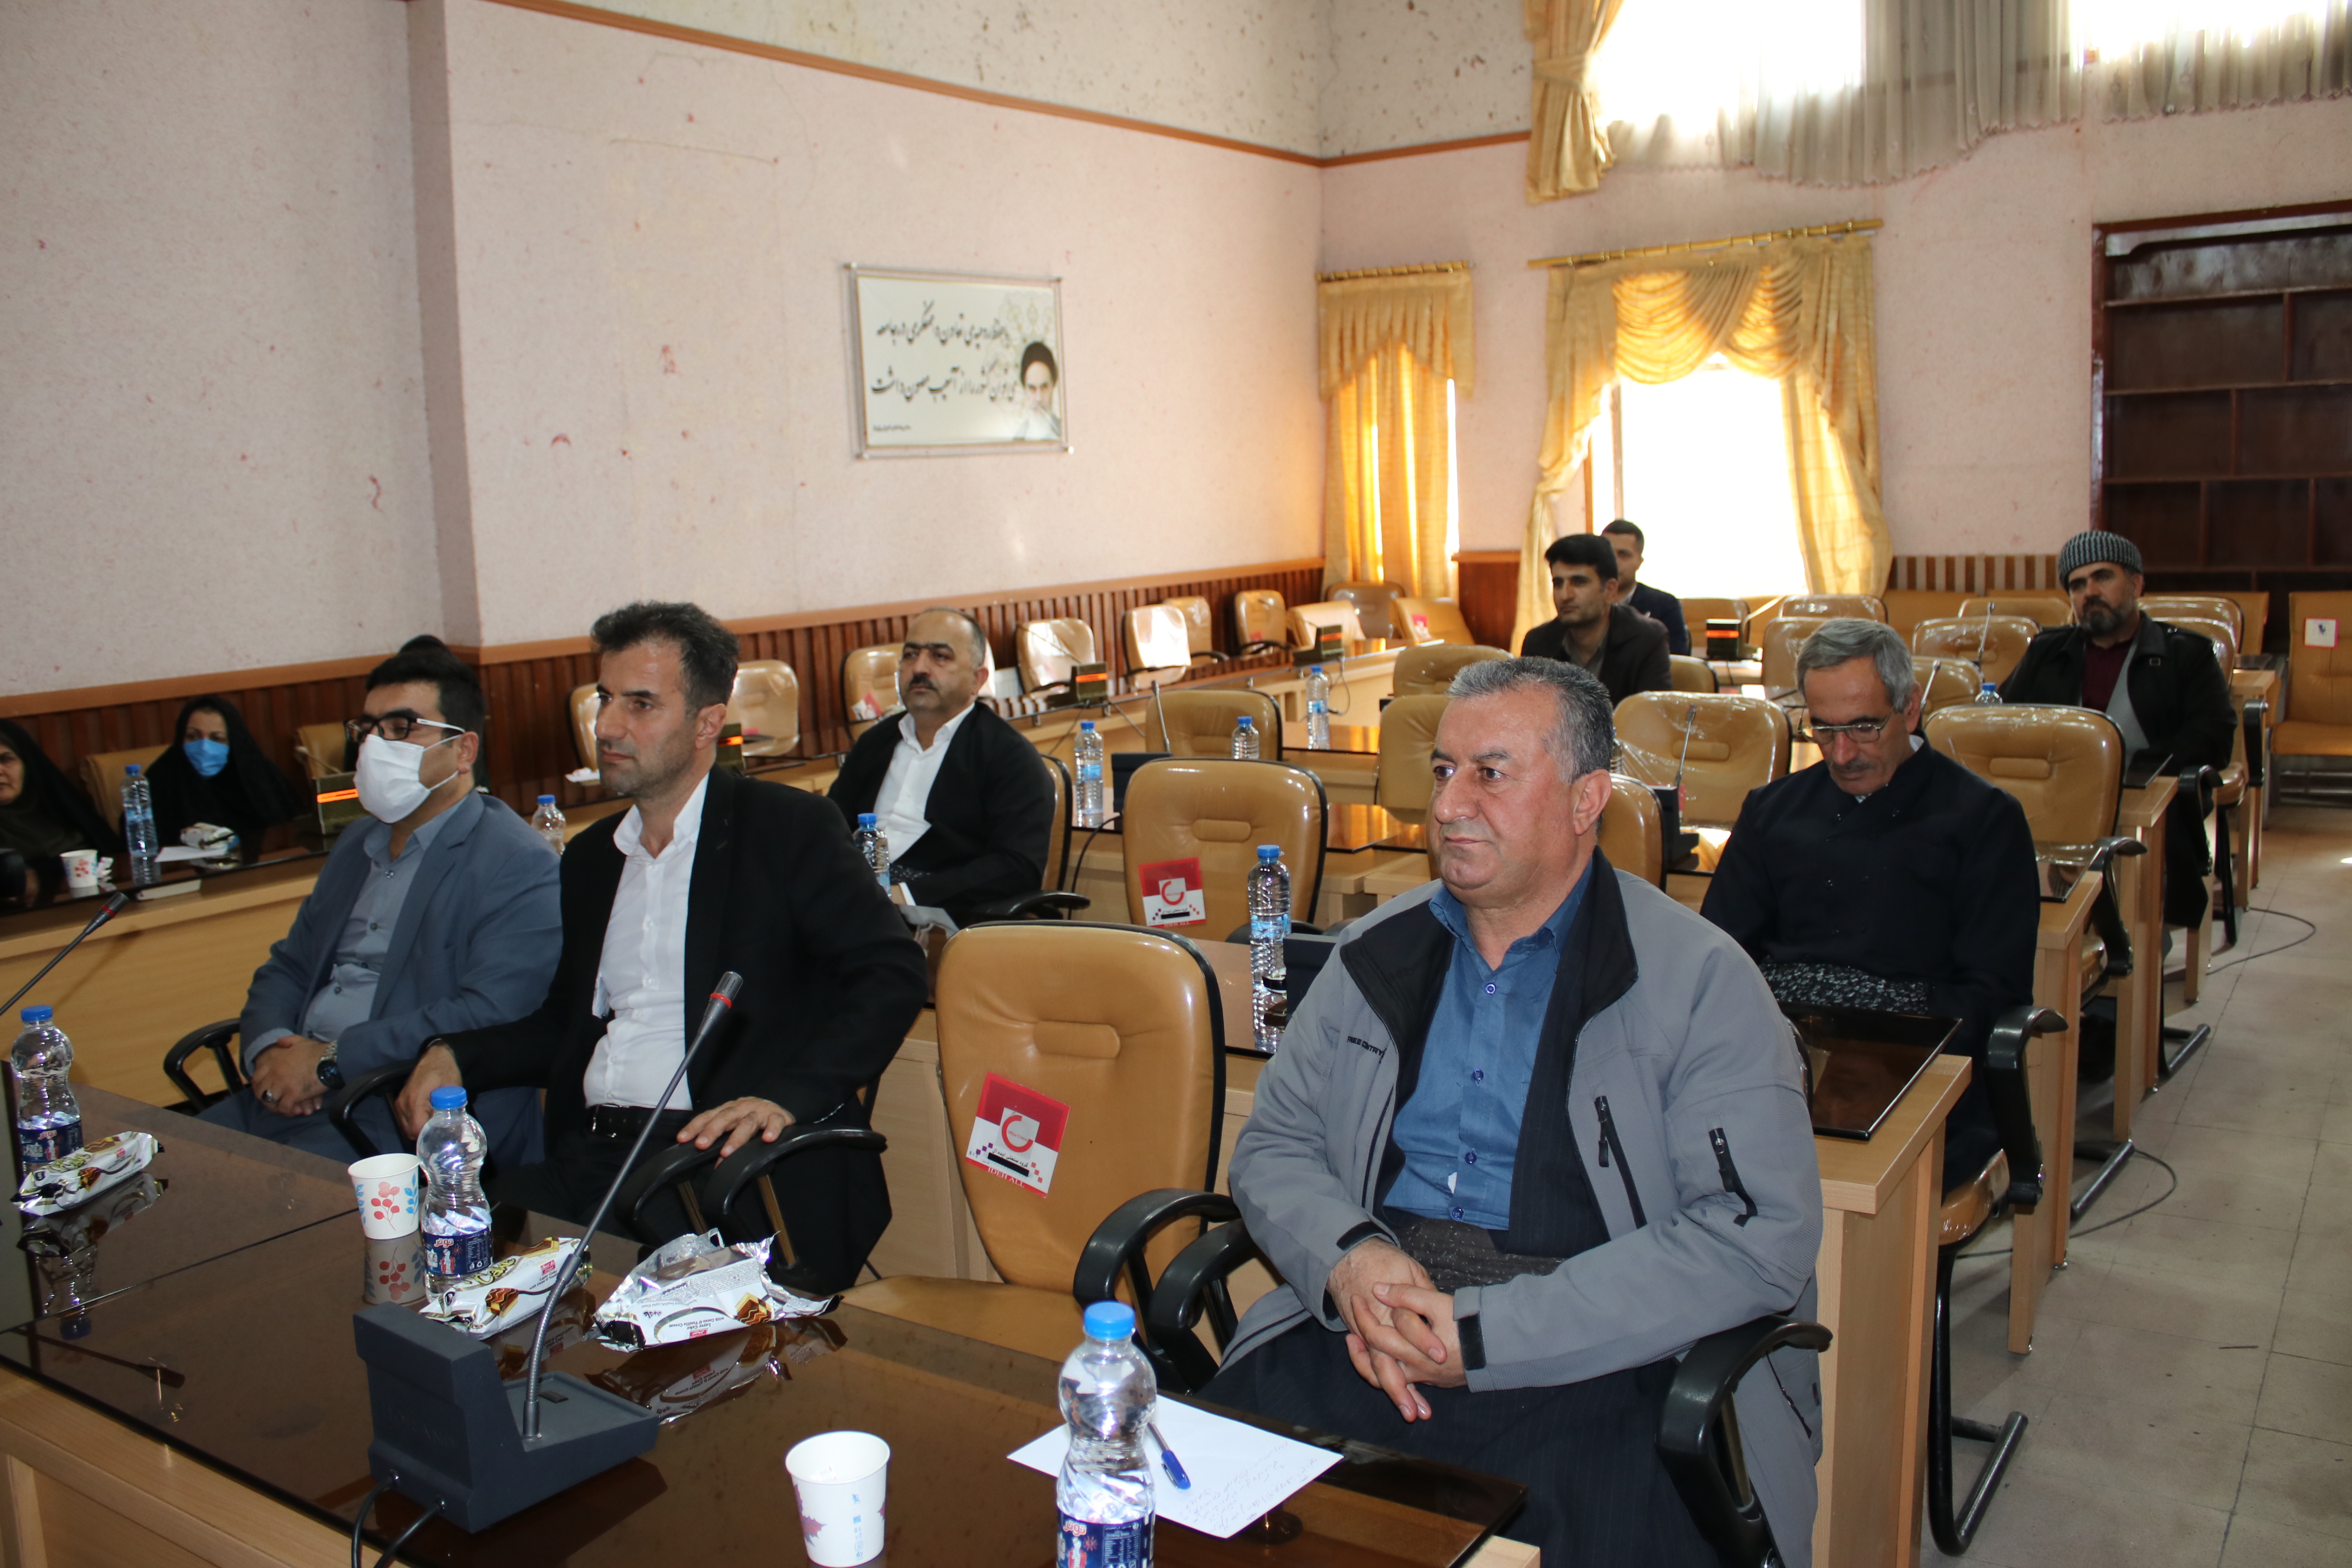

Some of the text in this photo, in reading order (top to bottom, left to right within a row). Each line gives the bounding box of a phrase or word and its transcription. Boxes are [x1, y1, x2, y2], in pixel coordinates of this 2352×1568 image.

[988, 1167, 1025, 1188] IDEH ALL
[433, 1237, 454, 1248] توتر
[1063, 1520, 1087, 1537] توتر
